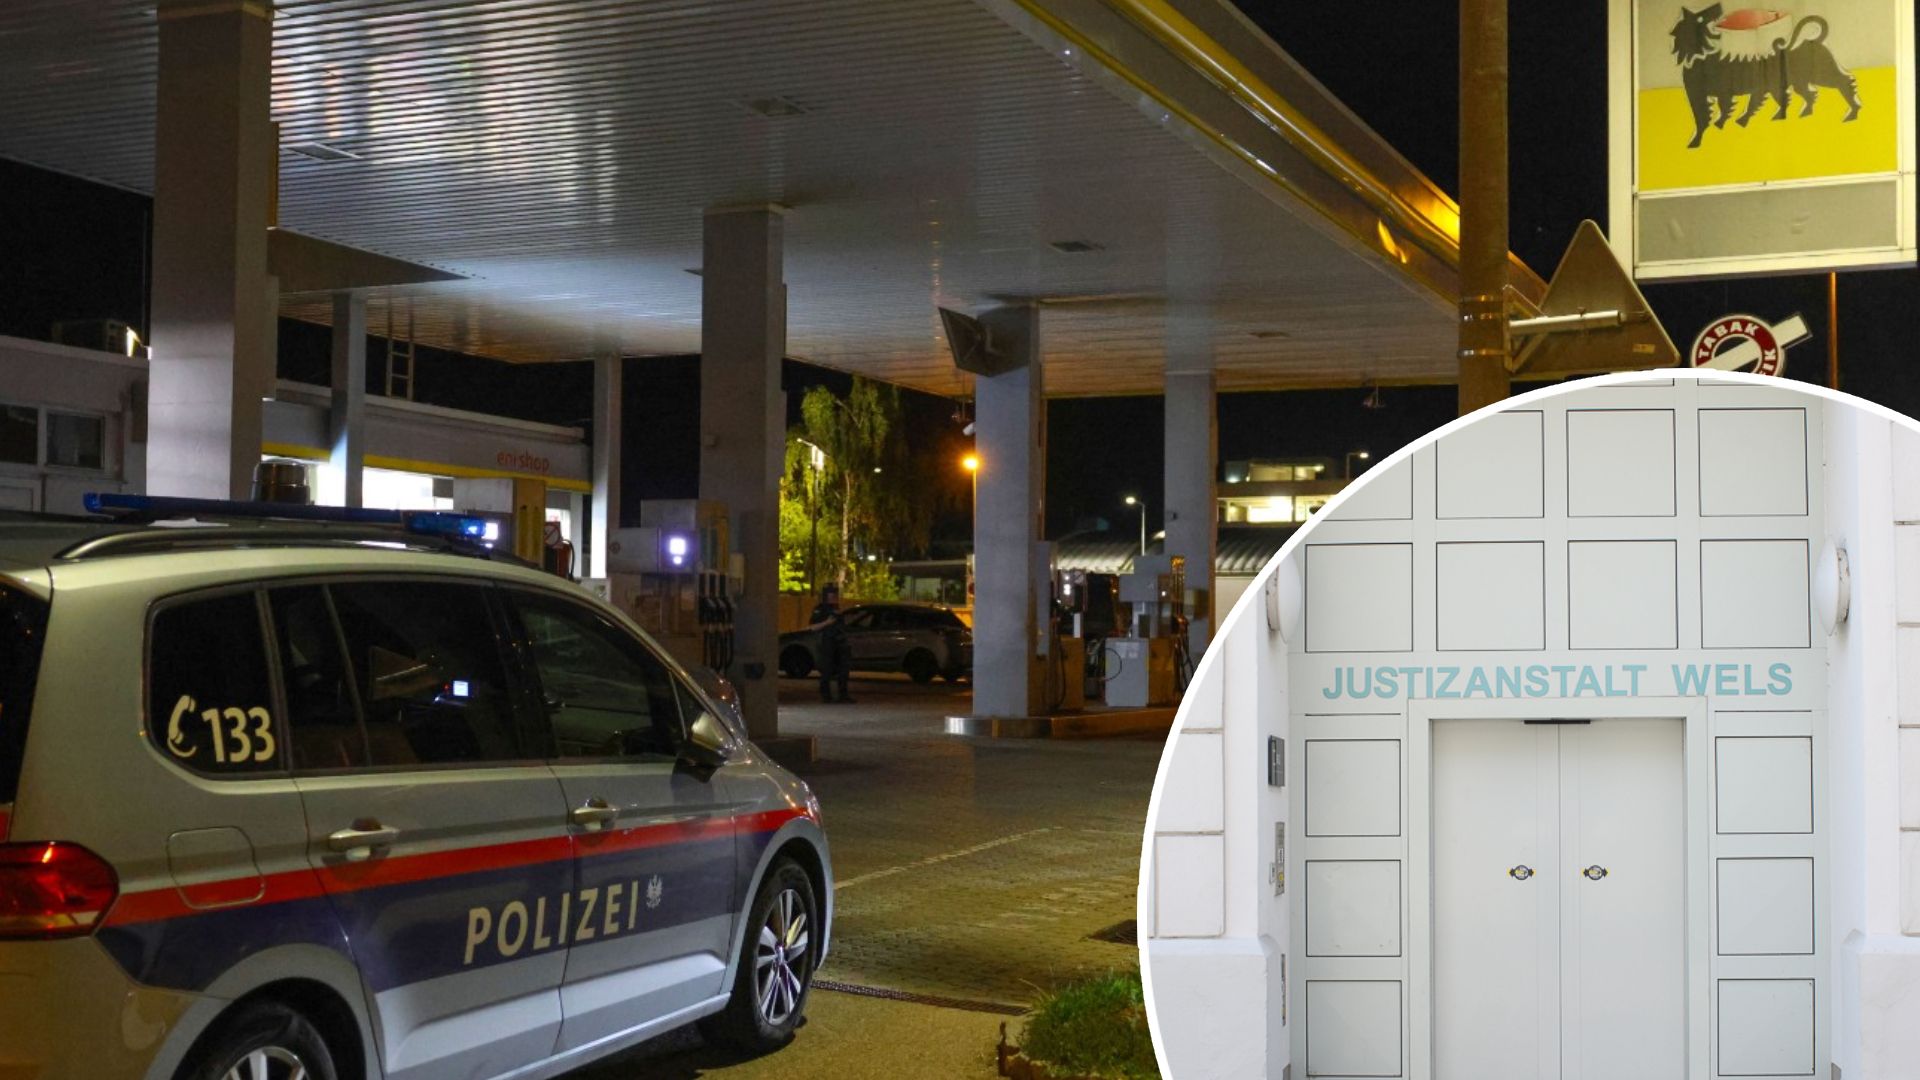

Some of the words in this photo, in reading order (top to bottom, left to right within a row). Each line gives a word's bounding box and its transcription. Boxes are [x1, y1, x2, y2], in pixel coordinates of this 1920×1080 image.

[1698, 321, 1759, 358] TABAK
[1322, 664, 1648, 699] JUSTIZANSTALT
[1671, 663, 1793, 697] WELS
[201, 706, 275, 762] 133
[463, 880, 639, 966] POLIZEI
